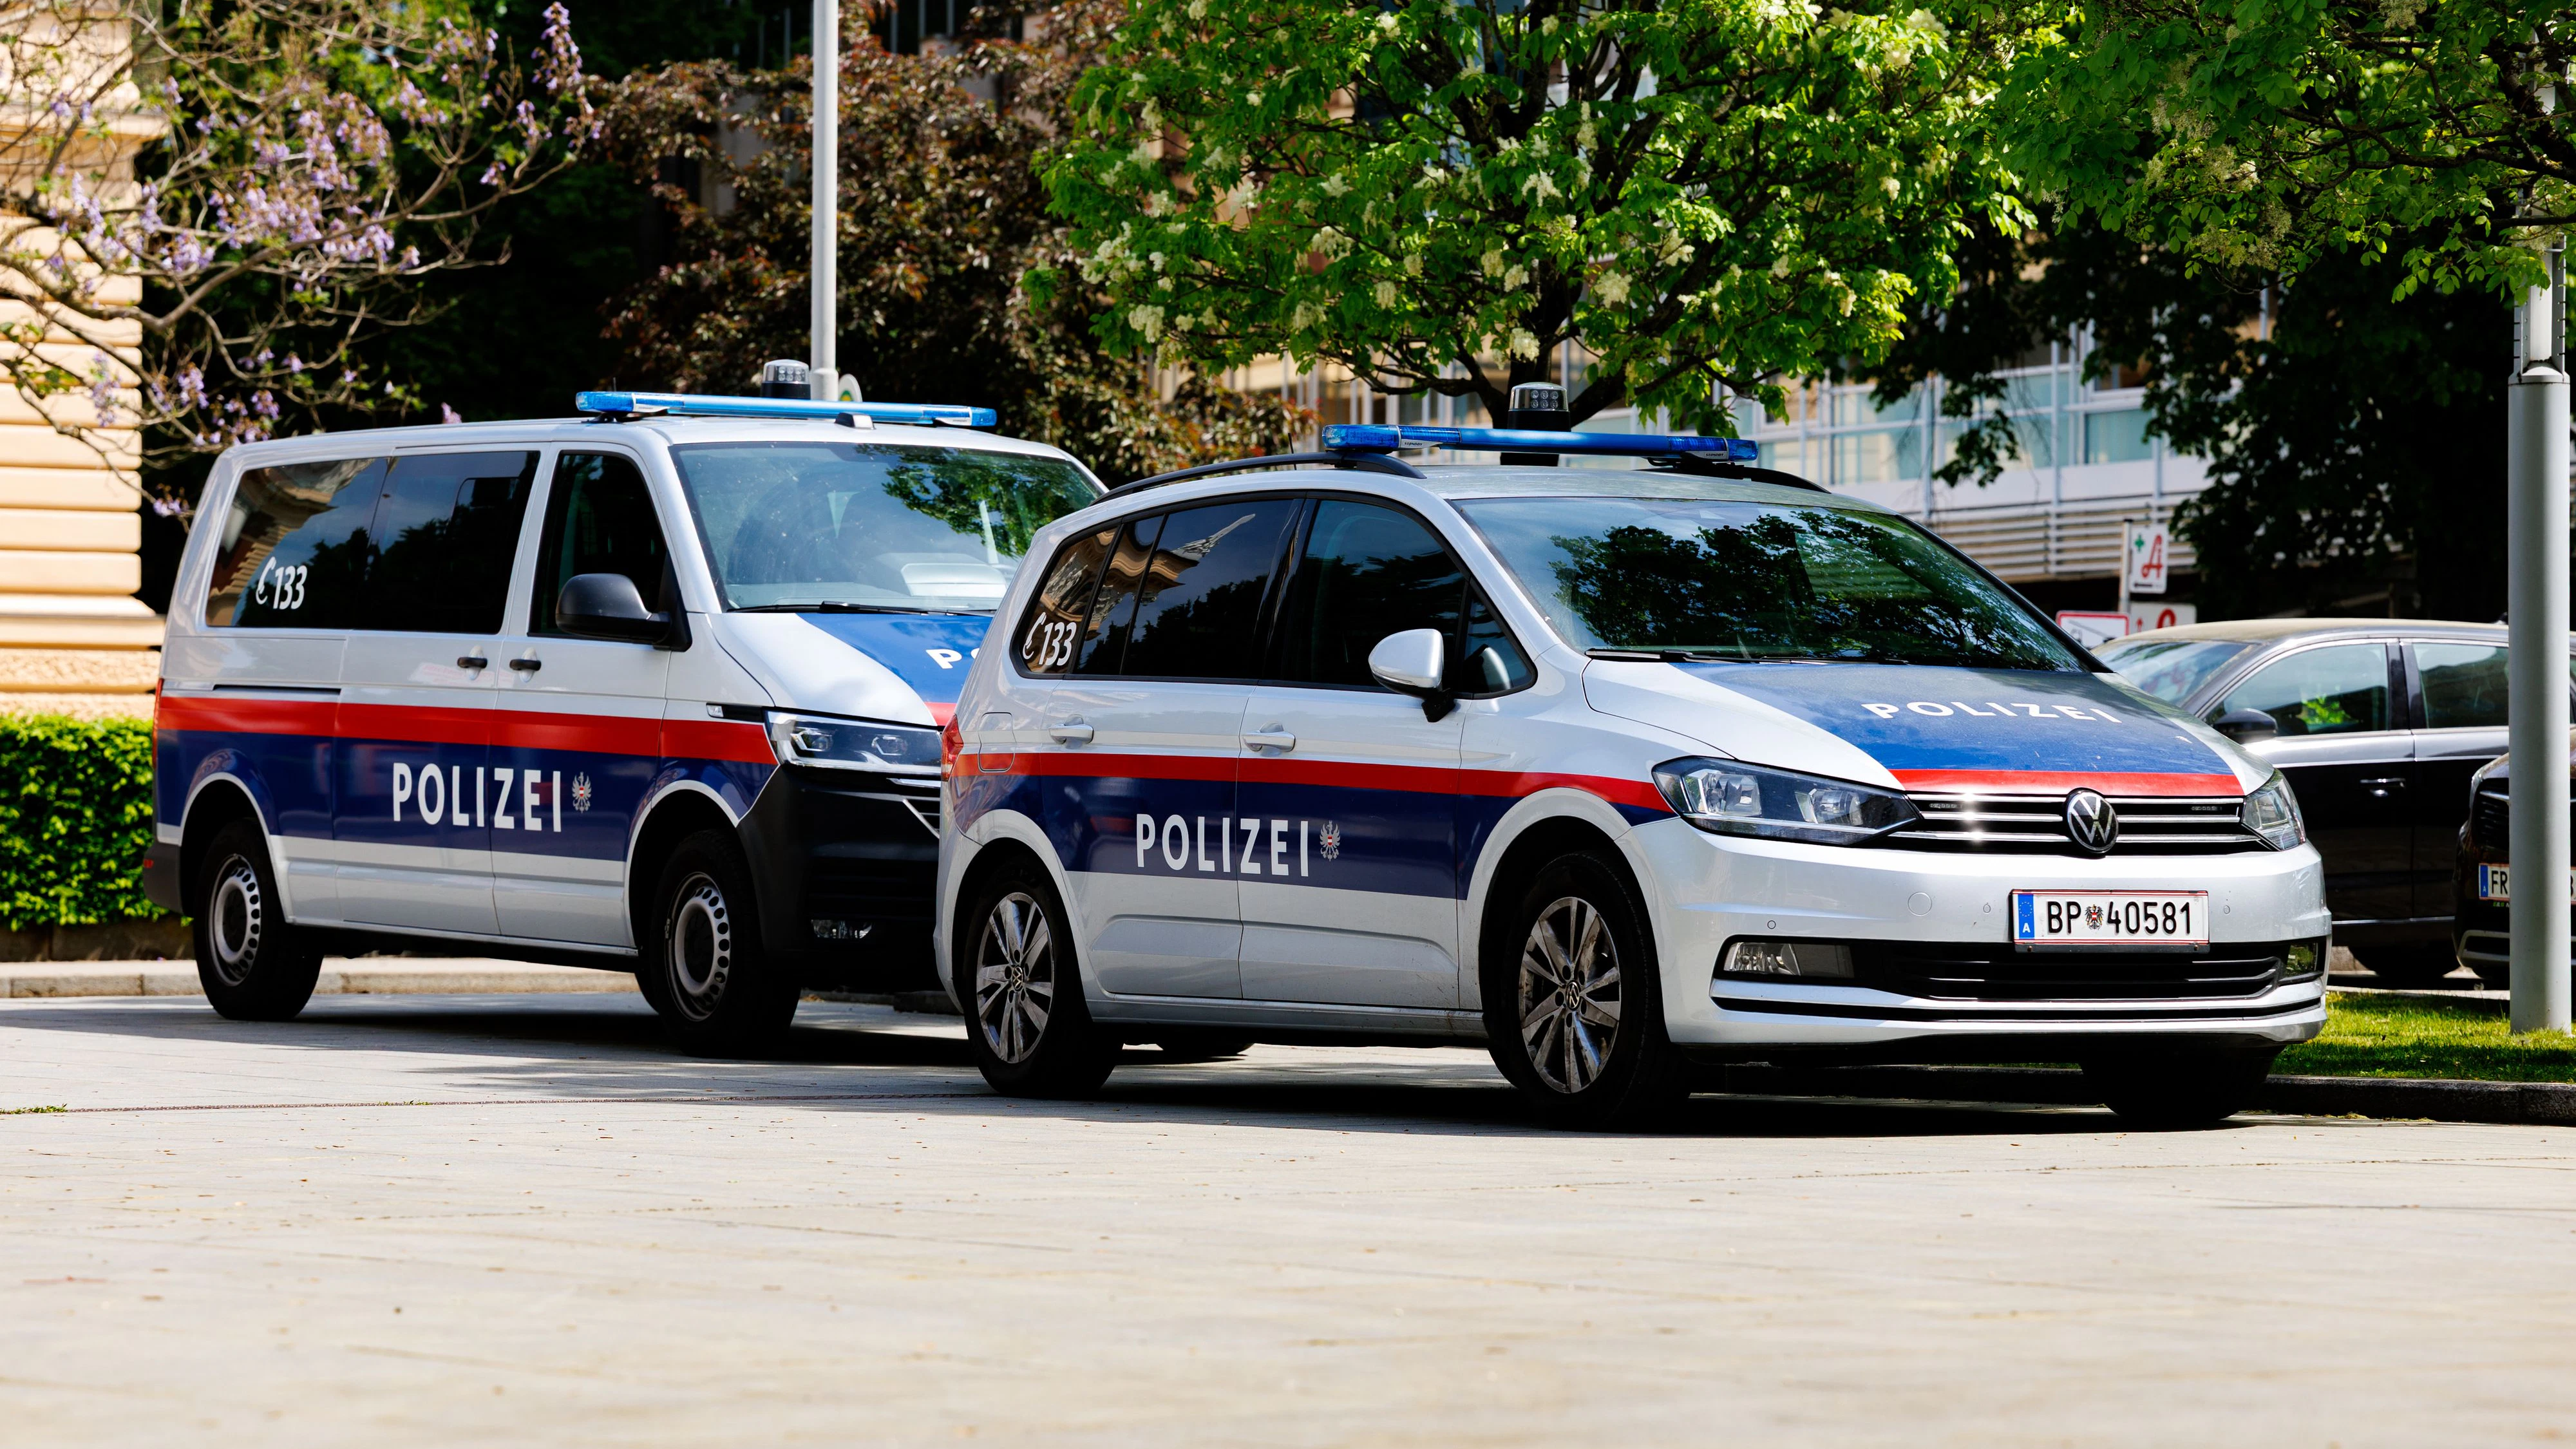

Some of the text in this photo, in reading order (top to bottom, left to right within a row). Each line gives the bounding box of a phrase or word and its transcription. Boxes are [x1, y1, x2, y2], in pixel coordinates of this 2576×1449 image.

[2141, 535, 2163, 578] A
[273, 565, 307, 610] 133
[925, 647, 980, 669] P
[1038, 621, 1077, 666] 133
[1861, 701, 2123, 723] POLIZEI
[393, 762, 562, 833] POLIZEI
[1136, 813, 1309, 877] POLIZEI
[2491, 870, 2508, 895] FR
[2022, 922, 2031, 933] A
[2047, 901, 2190, 934] BP 40581
